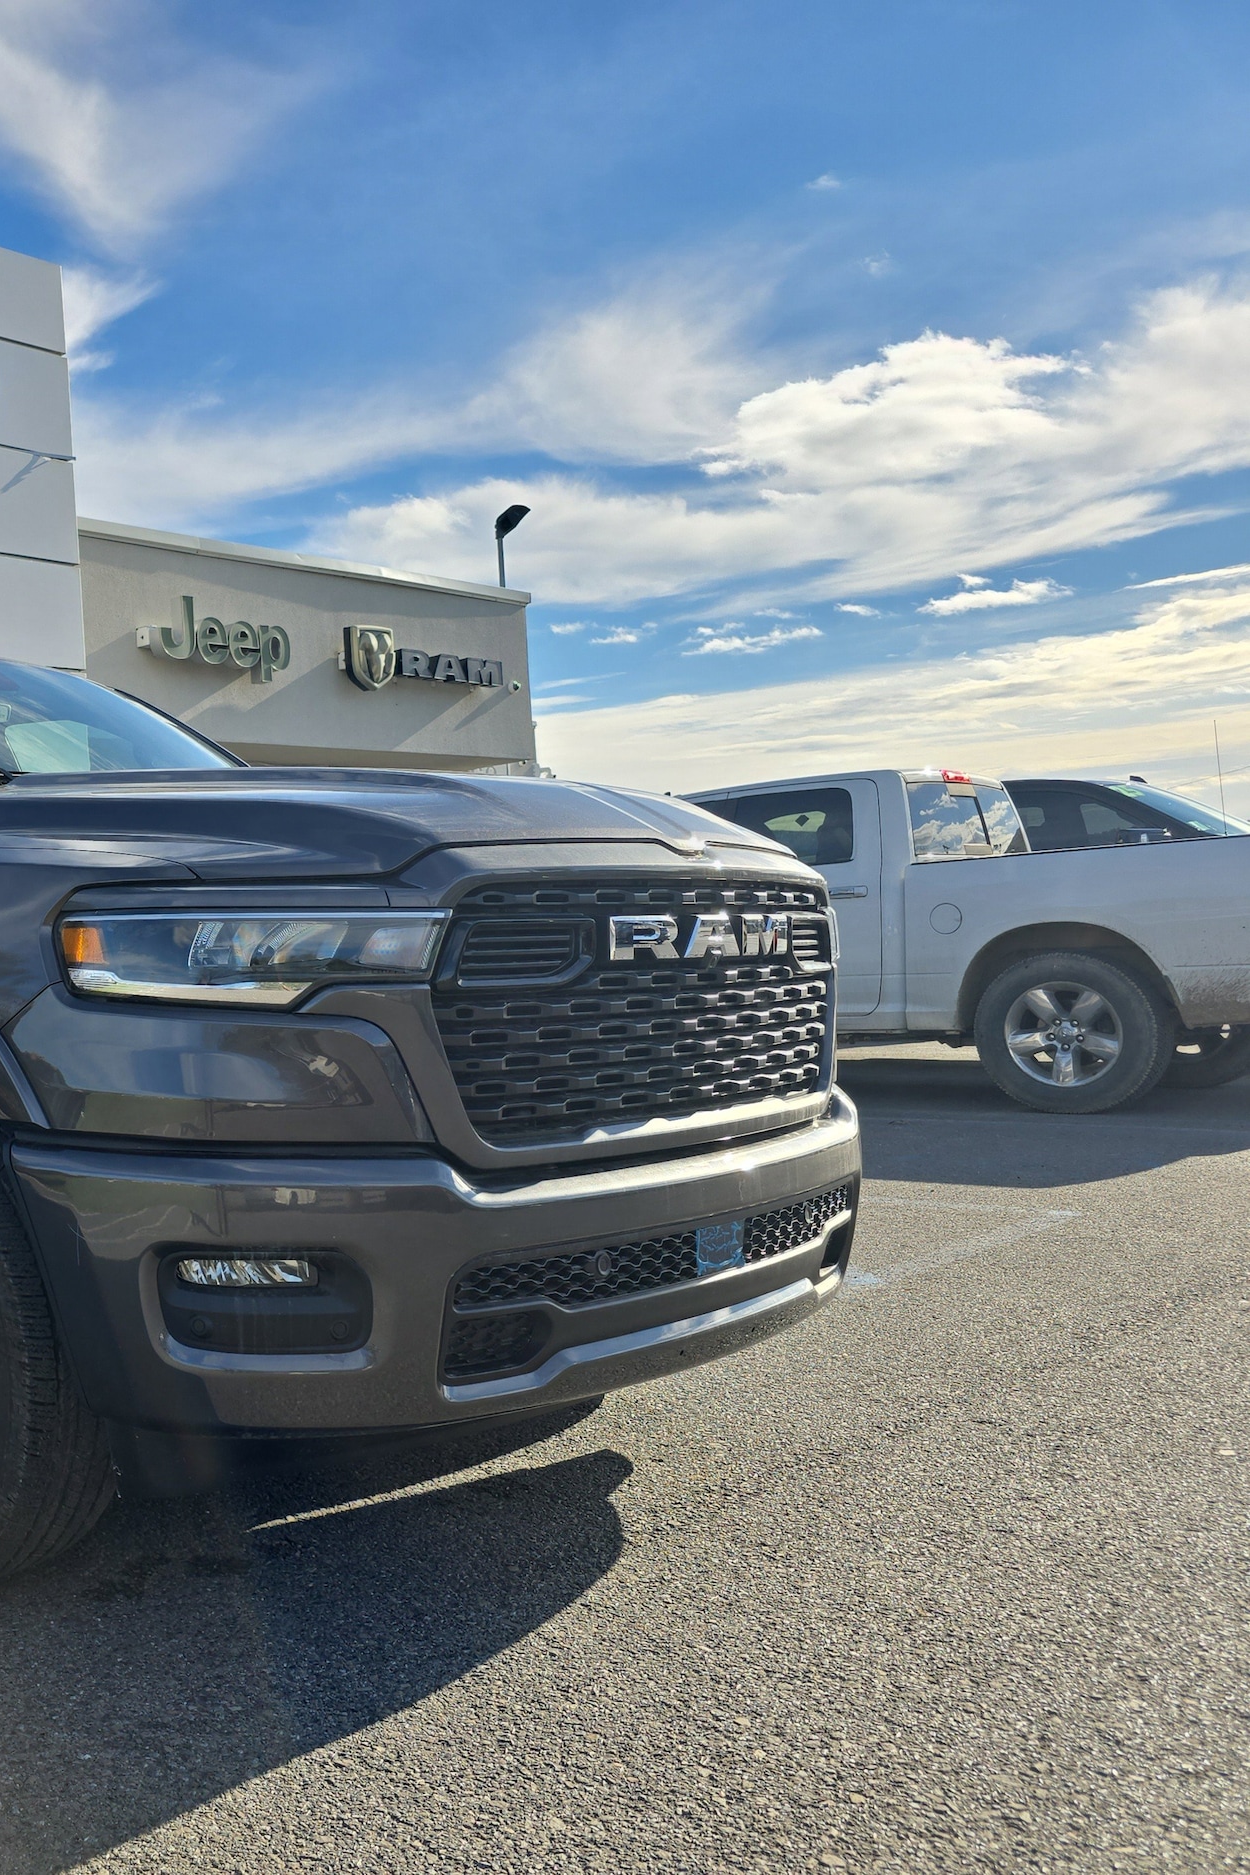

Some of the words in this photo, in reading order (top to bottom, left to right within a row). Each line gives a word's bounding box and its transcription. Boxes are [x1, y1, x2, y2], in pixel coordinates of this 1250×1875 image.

[153, 595, 291, 683] Jeep
[395, 648, 503, 687] RAM
[610, 912, 788, 960] RAM
